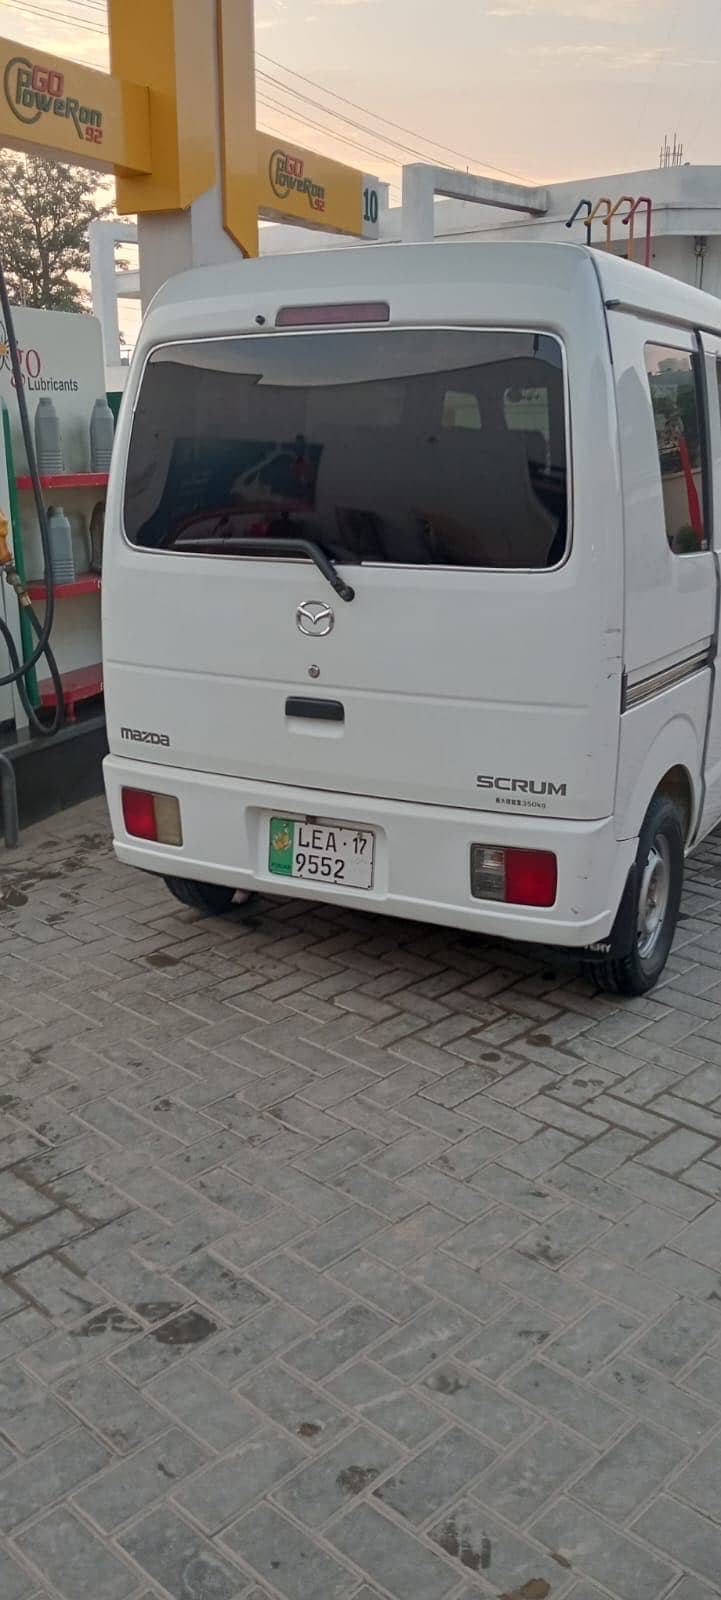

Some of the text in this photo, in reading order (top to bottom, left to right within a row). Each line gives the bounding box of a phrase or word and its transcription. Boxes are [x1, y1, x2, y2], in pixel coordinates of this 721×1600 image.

[85, 126, 103, 144] 92
[314, 199, 325, 212] 92
[363, 187, 378, 223] 10
[27, 376, 79, 391] Lubricants
[476, 775, 567, 796] SCRUM
[298, 827, 368, 855] LEA 17
[295, 853, 345, 879] 9552
